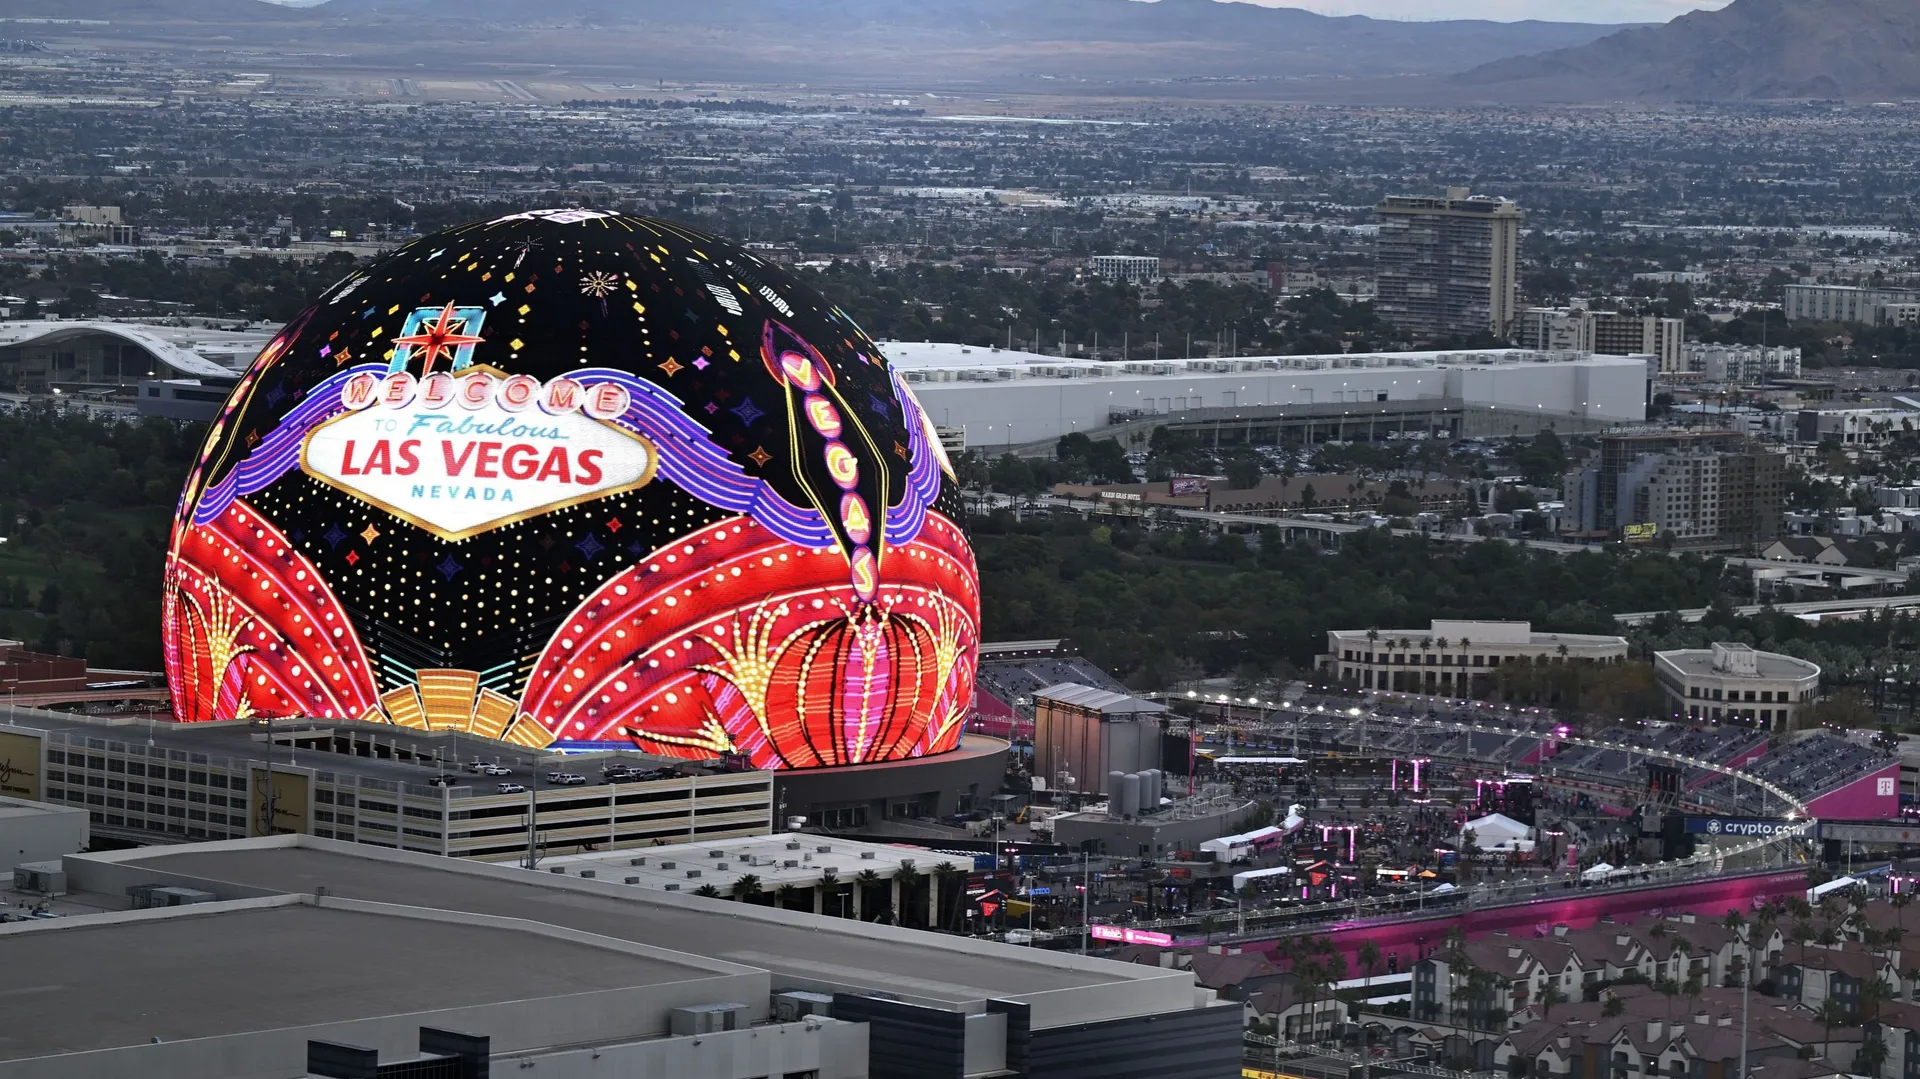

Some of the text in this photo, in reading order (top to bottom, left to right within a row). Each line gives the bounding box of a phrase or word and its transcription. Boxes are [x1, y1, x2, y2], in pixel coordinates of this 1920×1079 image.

[347, 375, 624, 415] WELCOME
[375, 414, 570, 440] TO Fabulous
[340, 439, 604, 486] LAS VEGAS
[781, 357, 873, 594] VEGAS
[411, 484, 514, 502] NEVADA
